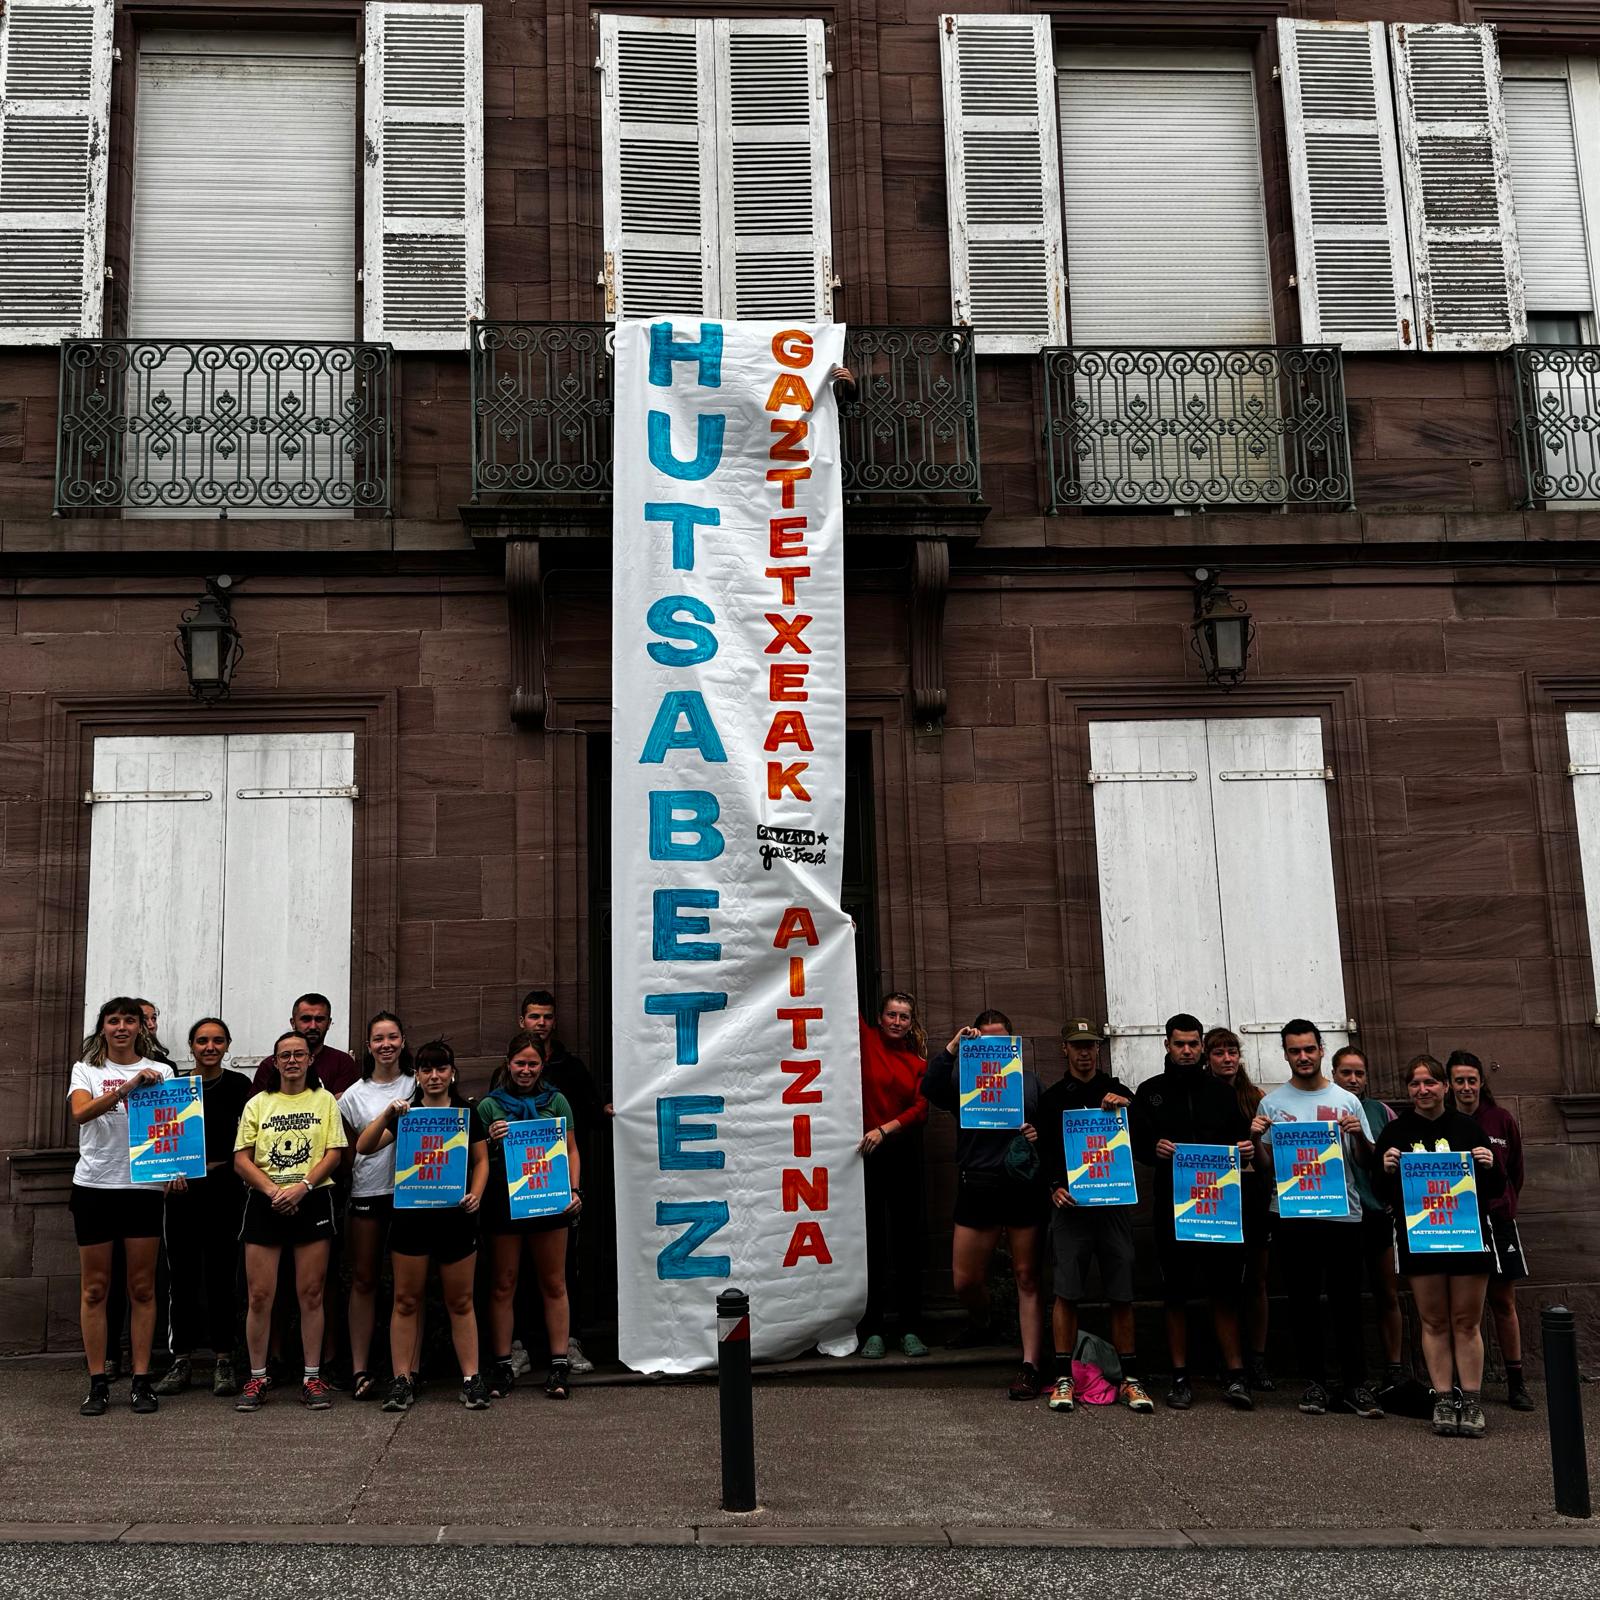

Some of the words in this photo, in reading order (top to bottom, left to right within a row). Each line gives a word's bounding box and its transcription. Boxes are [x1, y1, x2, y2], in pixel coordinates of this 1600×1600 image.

[764, 330, 814, 803] GAZTETXEAK
[962, 1045, 1019, 1053] GARAZIKO
[981, 1061, 1002, 1074] BIZI
[773, 907, 832, 1267] AITZINA
[976, 1076, 1007, 1089] BERRI
[131, 1087, 199, 1101] GARAZIKO
[981, 1090, 1002, 1103] BAT
[131, 1096, 199, 1108] GAZTETXEAK
[154, 1107, 178, 1123] BIZI
[401, 1118, 467, 1126] GARAZIKO
[1066, 1117, 1124, 1127] GARAZIKO
[148, 1121, 185, 1139] BERRI
[507, 1127, 563, 1140] GARAZIKO
[1066, 1126, 1125, 1134] GAZTETXEAK
[1274, 1130, 1337, 1140] GARAZIKO
[154, 1138, 179, 1154] BAT
[421, 1136, 444, 1150] BIZI
[507, 1135, 564, 1147] GAZTETXEAK
[1086, 1135, 1107, 1149] BIZI
[1276, 1138, 1337, 1146] GAZTETXEAK
[414, 1151, 449, 1165] BERRI
[525, 1146, 546, 1161] BIZI
[1082, 1150, 1114, 1165] BERRI
[1176, 1153, 1237, 1163] GARAZIKO
[1296, 1148, 1319, 1162] BIZI
[521, 1160, 553, 1176] BERRI
[1088, 1165, 1110, 1179] BAT
[1176, 1161, 1236, 1169] GAZTETXEAK
[1292, 1162, 1327, 1177] BERRI
[1404, 1161, 1471, 1171] GARAZIKO
[418, 1167, 443, 1181] BAT
[1195, 1171, 1217, 1186] BIZI
[1405, 1170, 1471, 1178] GAZTETXEAK
[528, 1176, 548, 1191] BAT
[1298, 1177, 1322, 1192] BAT
[1426, 1180, 1451, 1195] BIZI
[1190, 1185, 1224, 1201] BERRI
[1195, 1201, 1217, 1215] BAT
[1421, 1195, 1459, 1211] BERRI
[1428, 1211, 1453, 1226] BAT
